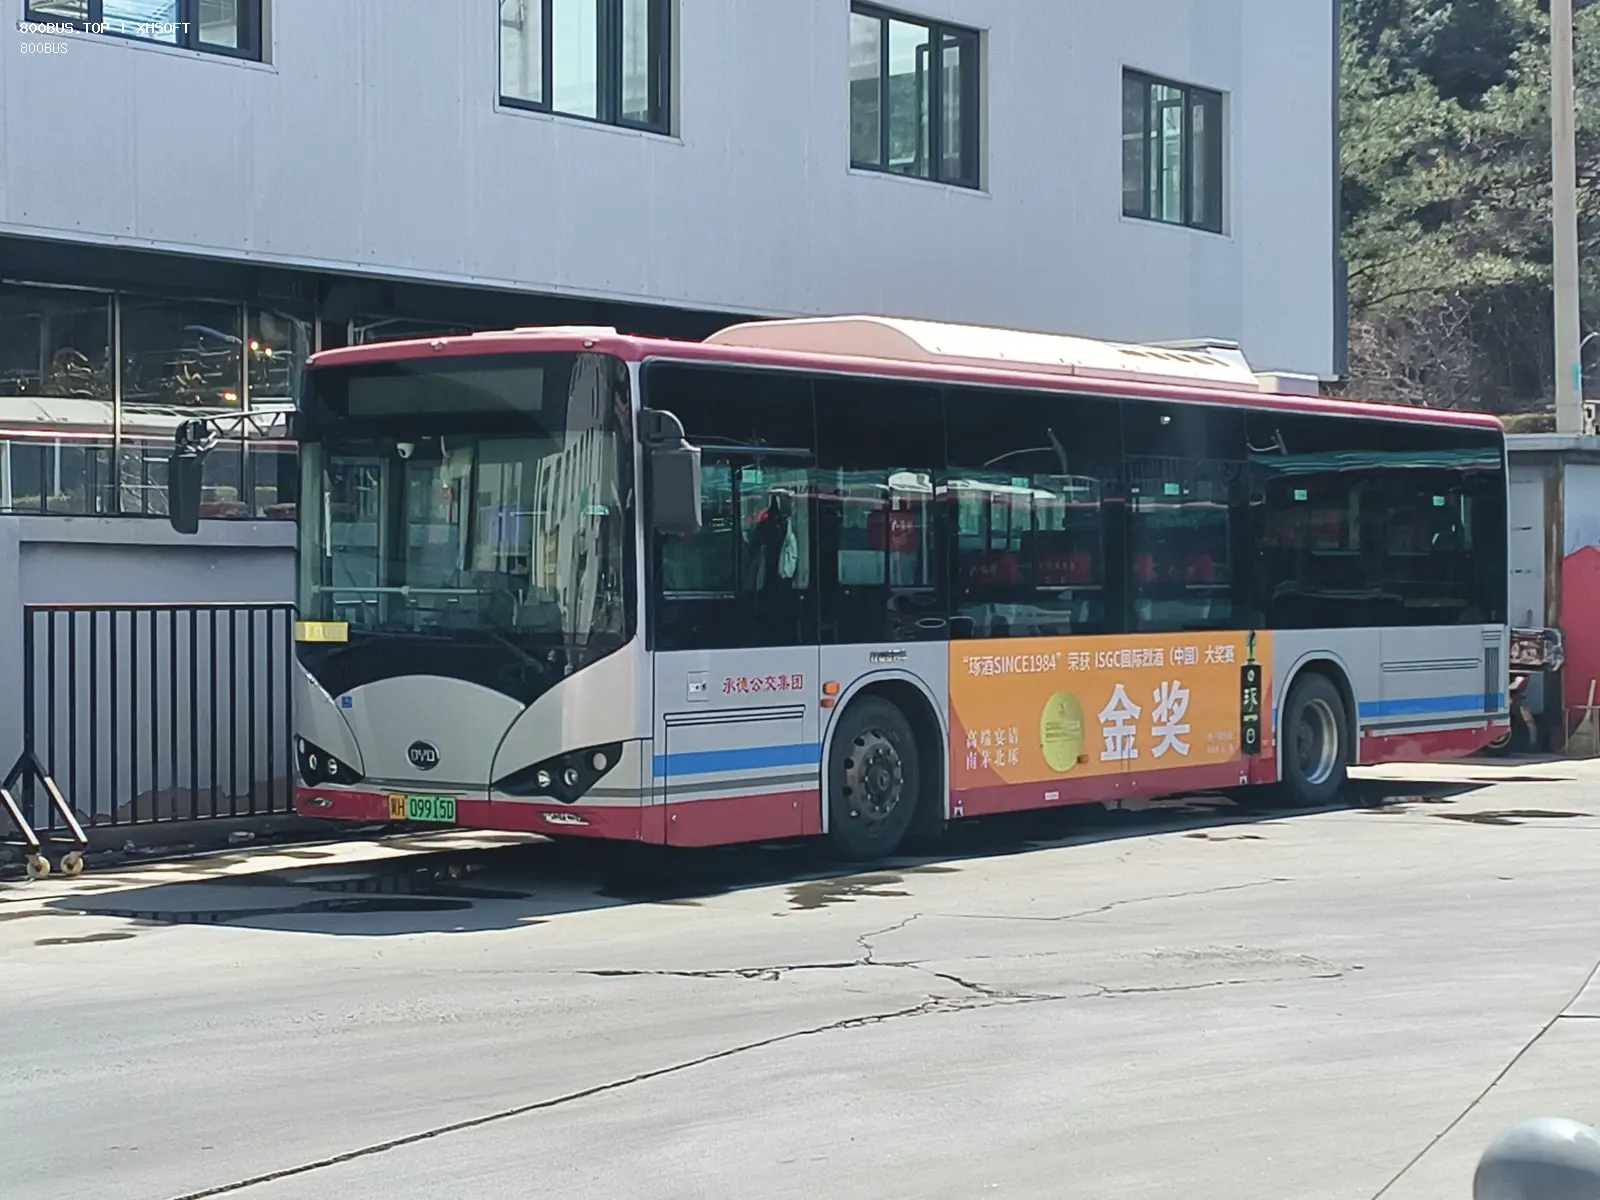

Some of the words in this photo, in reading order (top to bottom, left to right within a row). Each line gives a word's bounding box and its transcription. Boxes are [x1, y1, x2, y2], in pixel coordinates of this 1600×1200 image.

[722, 674, 804, 695] 承德公交集团
[1097, 679, 1191, 761] 金奖
